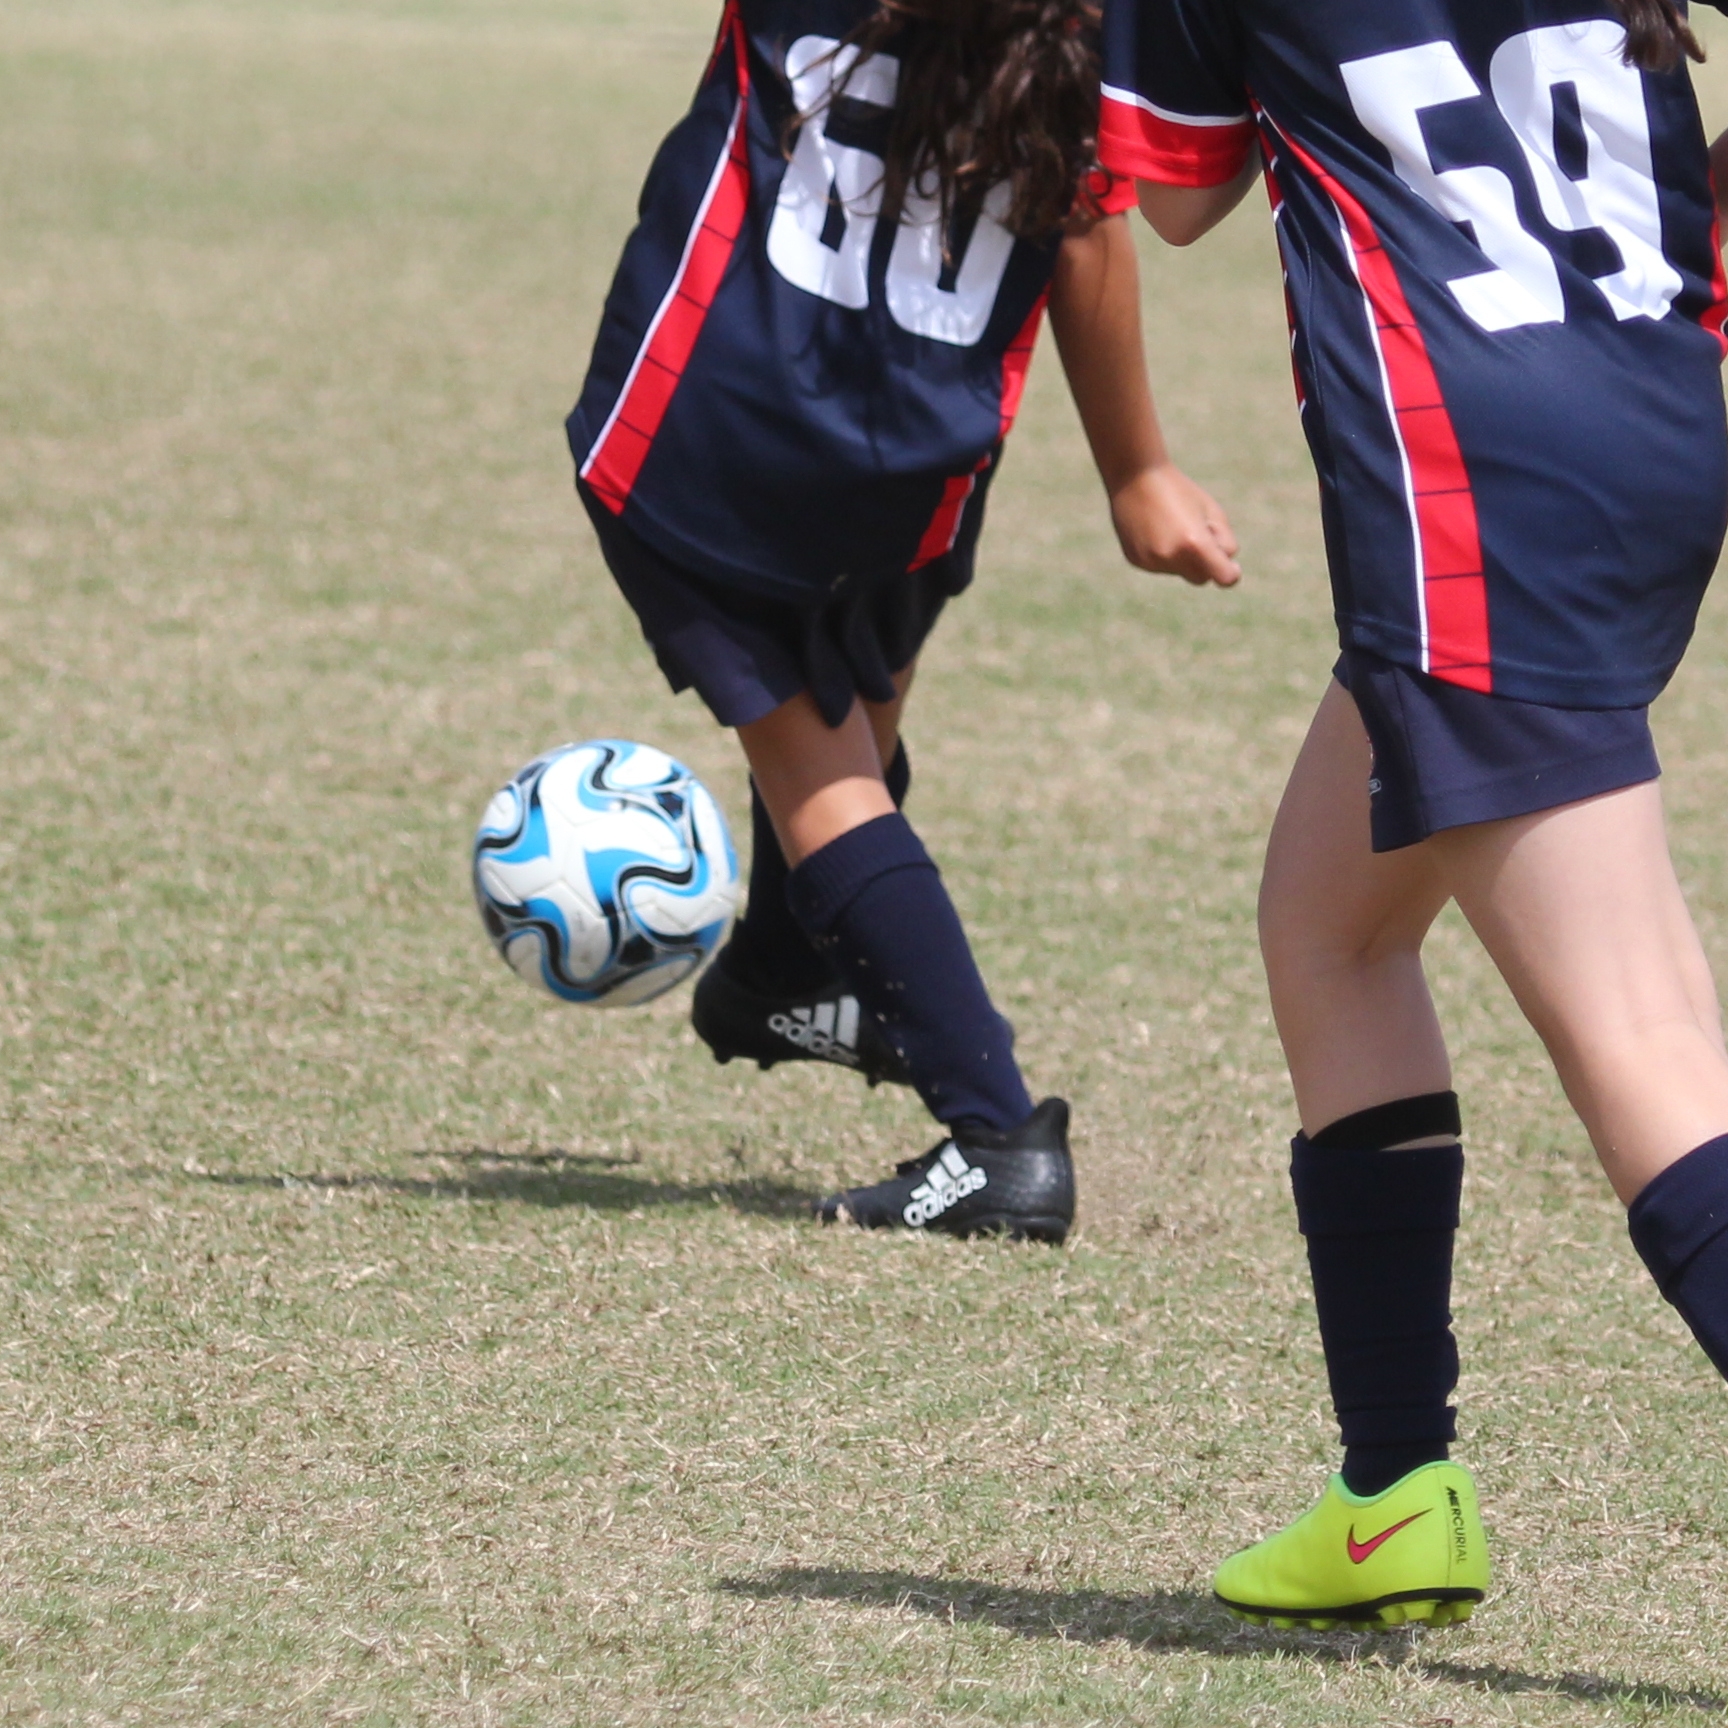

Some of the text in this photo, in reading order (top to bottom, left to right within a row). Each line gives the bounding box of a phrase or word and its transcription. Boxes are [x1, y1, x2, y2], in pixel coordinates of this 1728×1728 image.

[767, 34, 1016, 347] 60
[1339, 19, 1683, 333] 59
[903, 1166, 988, 1227] adidas
[1446, 1485, 1467, 1565] MERCURIAL
